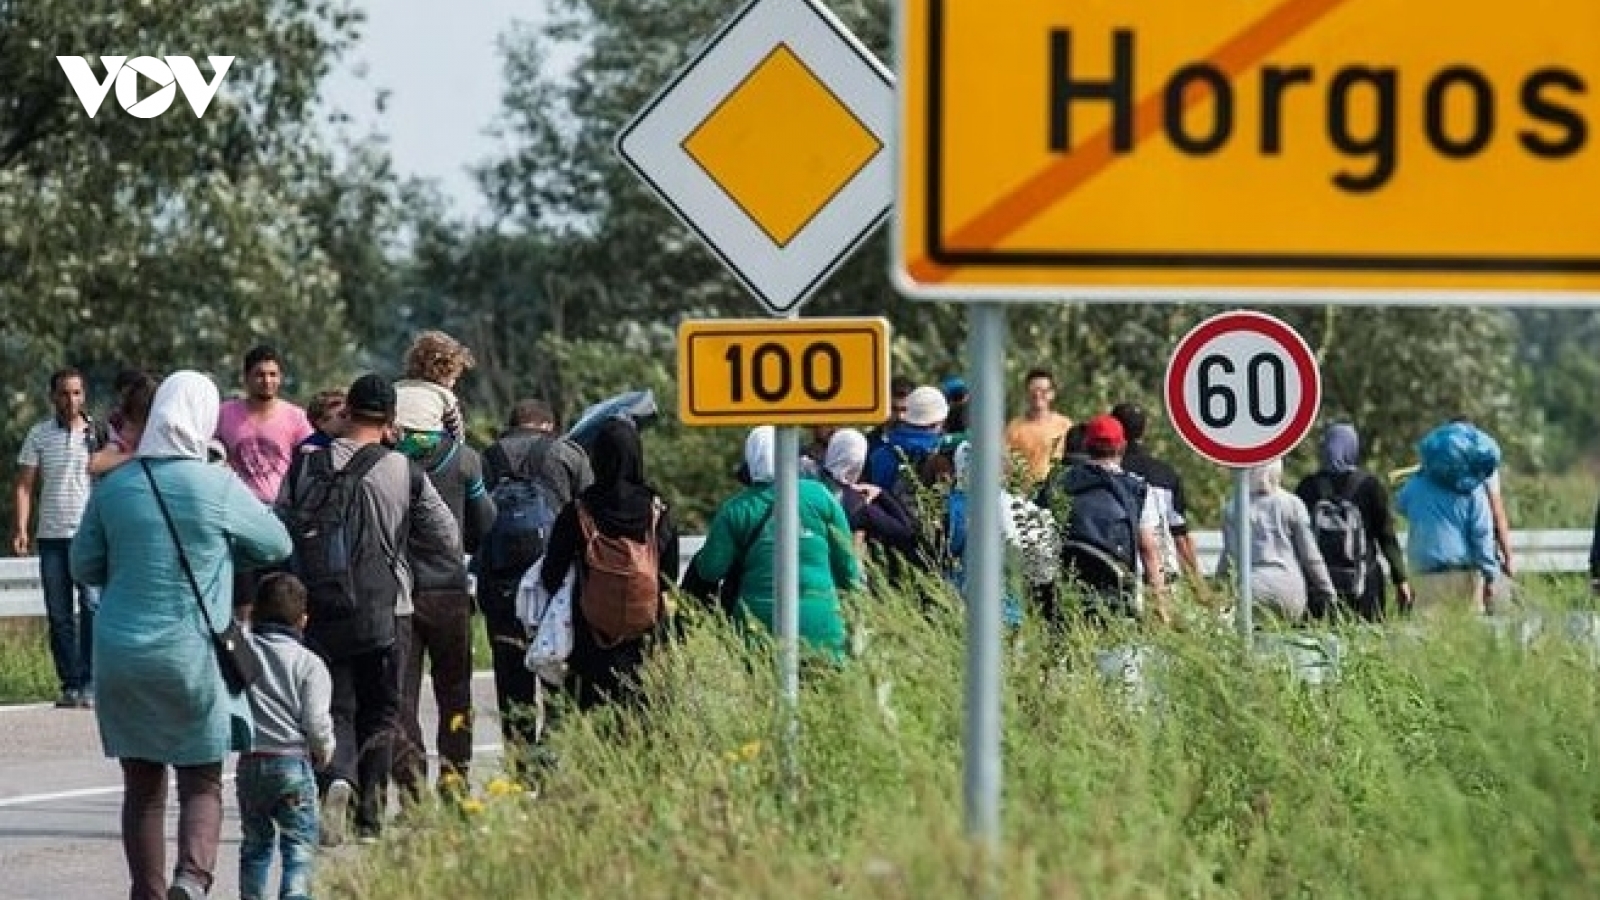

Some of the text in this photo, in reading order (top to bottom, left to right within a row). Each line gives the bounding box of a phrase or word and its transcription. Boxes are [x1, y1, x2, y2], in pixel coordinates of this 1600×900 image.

[1048, 28, 1588, 194] Horgos
[725, 342, 842, 403] 100
[1198, 352, 1286, 429] 60
